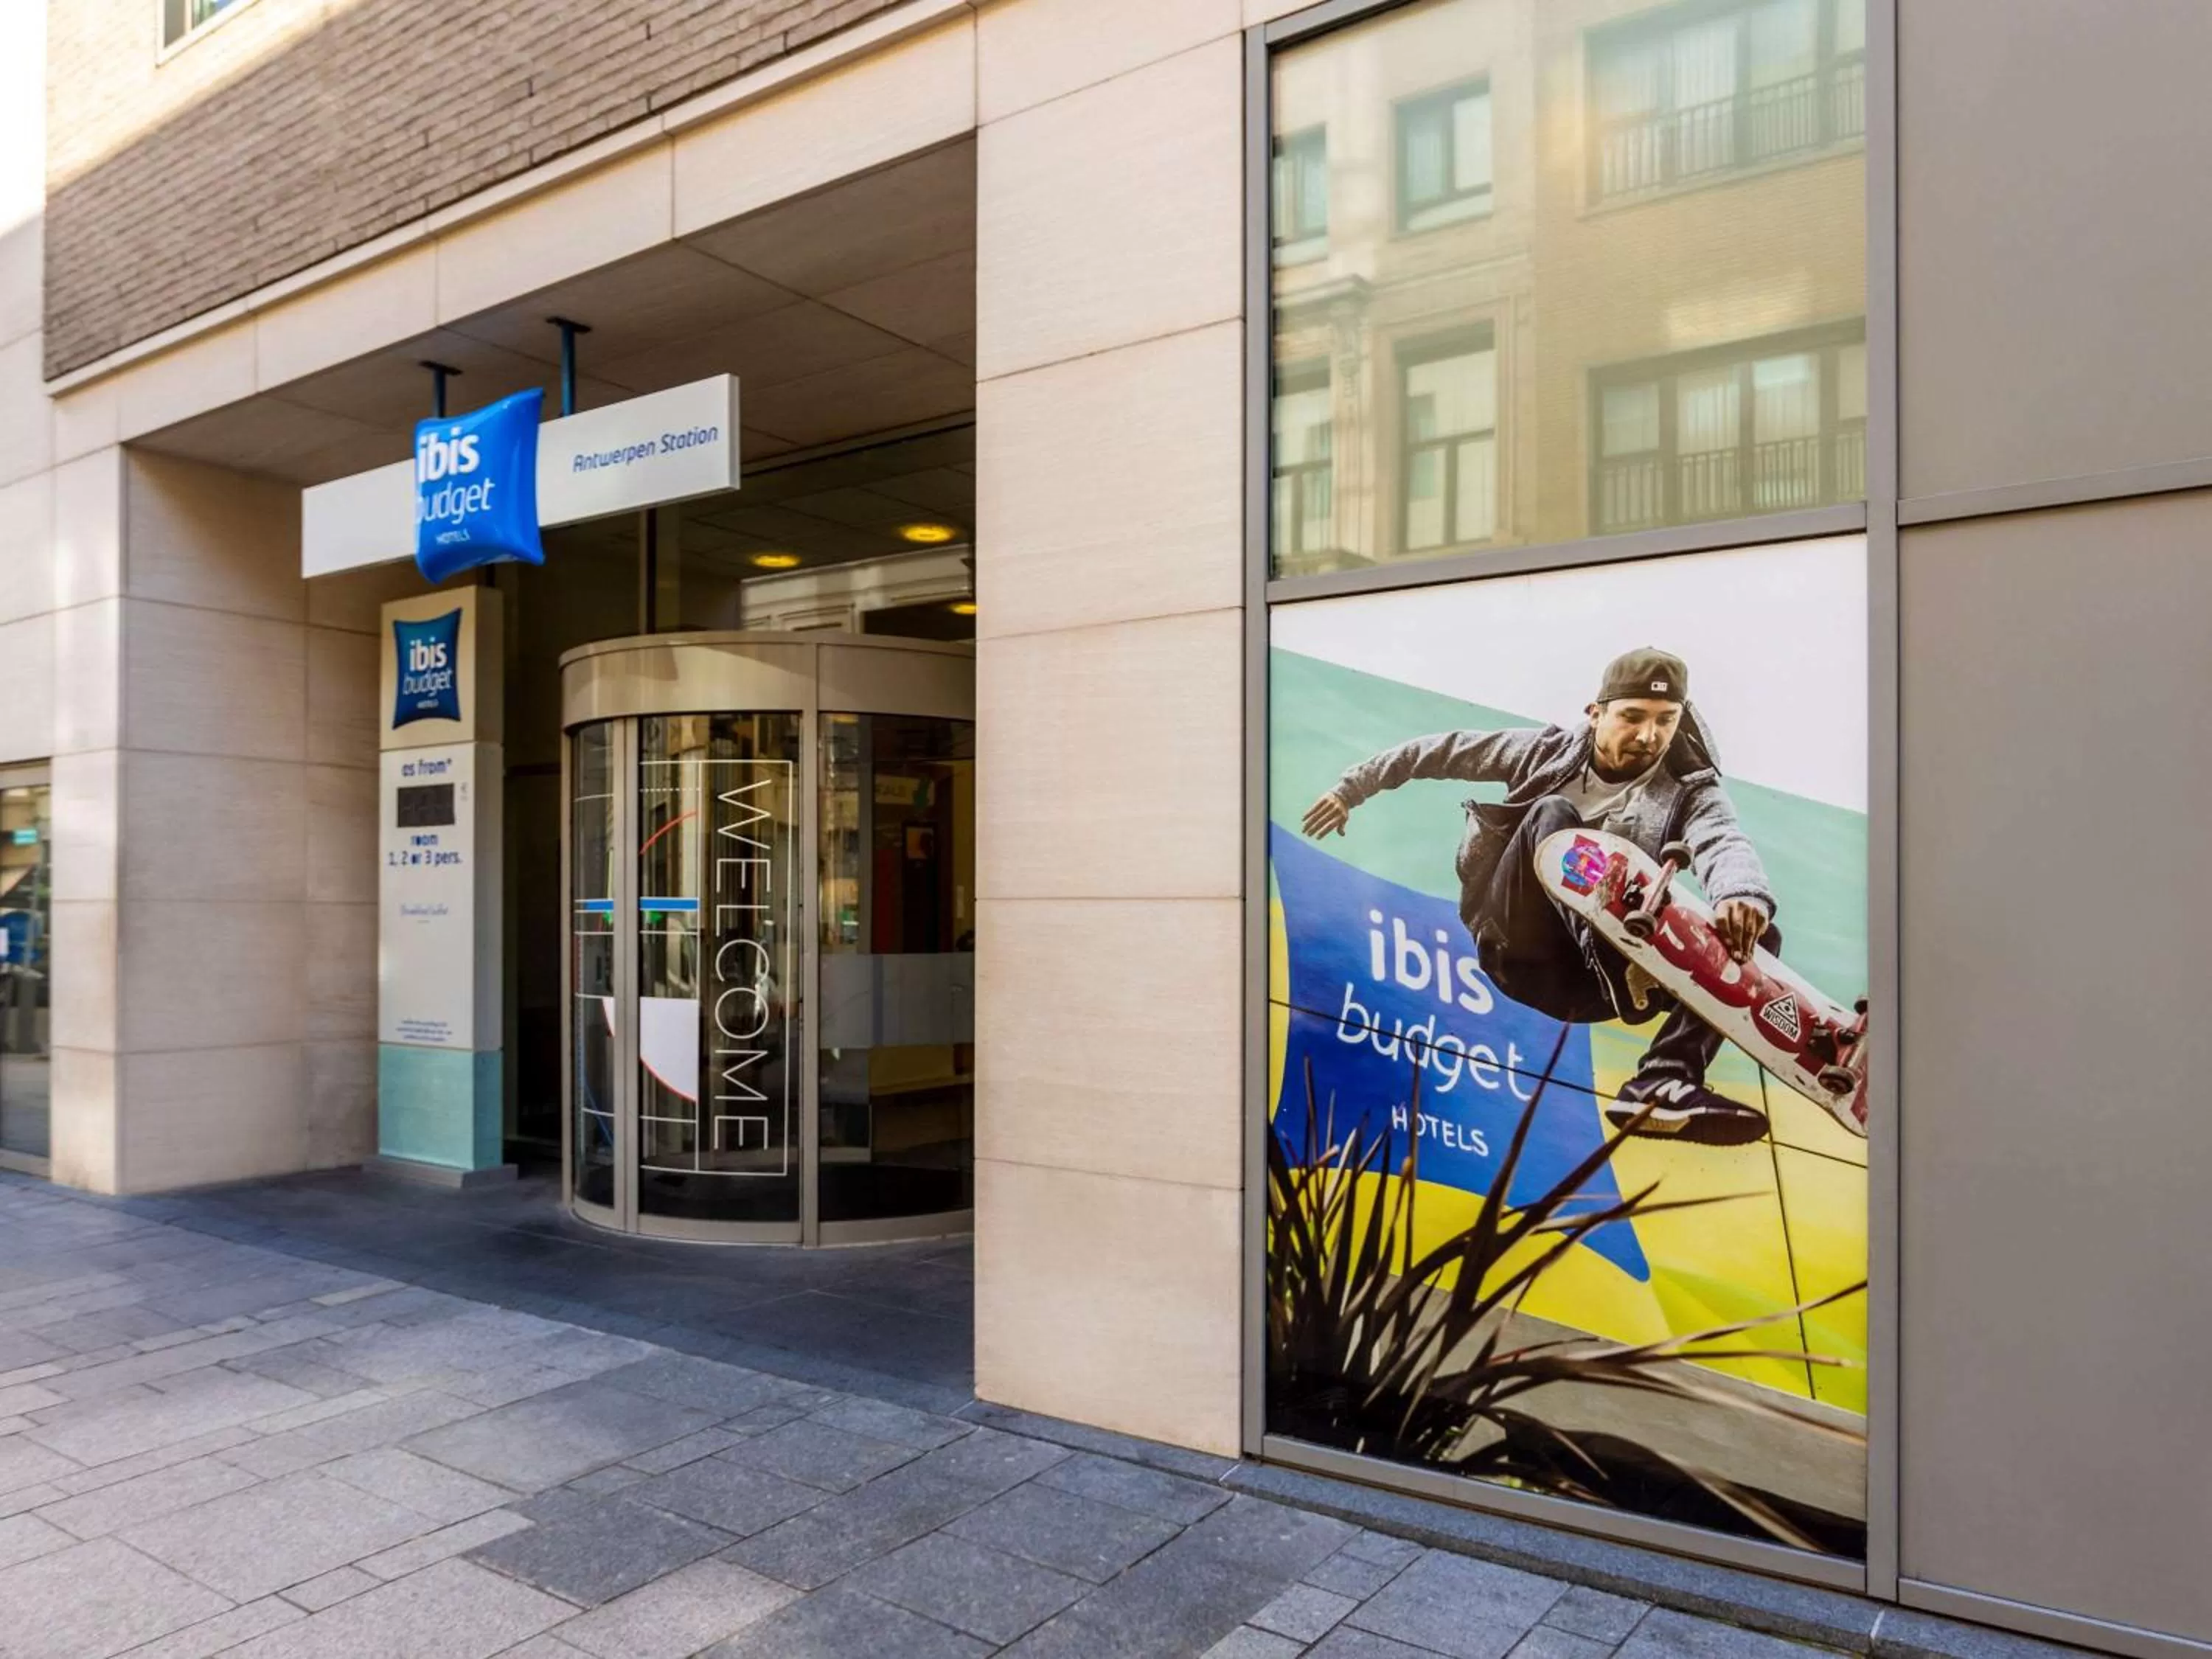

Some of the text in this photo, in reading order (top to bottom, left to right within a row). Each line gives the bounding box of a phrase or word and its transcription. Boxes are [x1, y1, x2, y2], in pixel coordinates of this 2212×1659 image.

[419, 426, 480, 484] ibis
[573, 425, 719, 473] Antwerpen Station
[409, 636, 448, 672] ibis
[403, 668, 453, 697] budget
[400, 850, 408, 866] 2
[410, 852, 422, 865] or
[424, 849, 432, 865] 3
[434, 850, 464, 867] pers.
[714, 778, 772, 1150] WELCOME
[1368, 909, 1494, 1015] ibis
[1337, 982, 1533, 1102] budget
[1763, 1006, 1798, 1039] WISDOM
